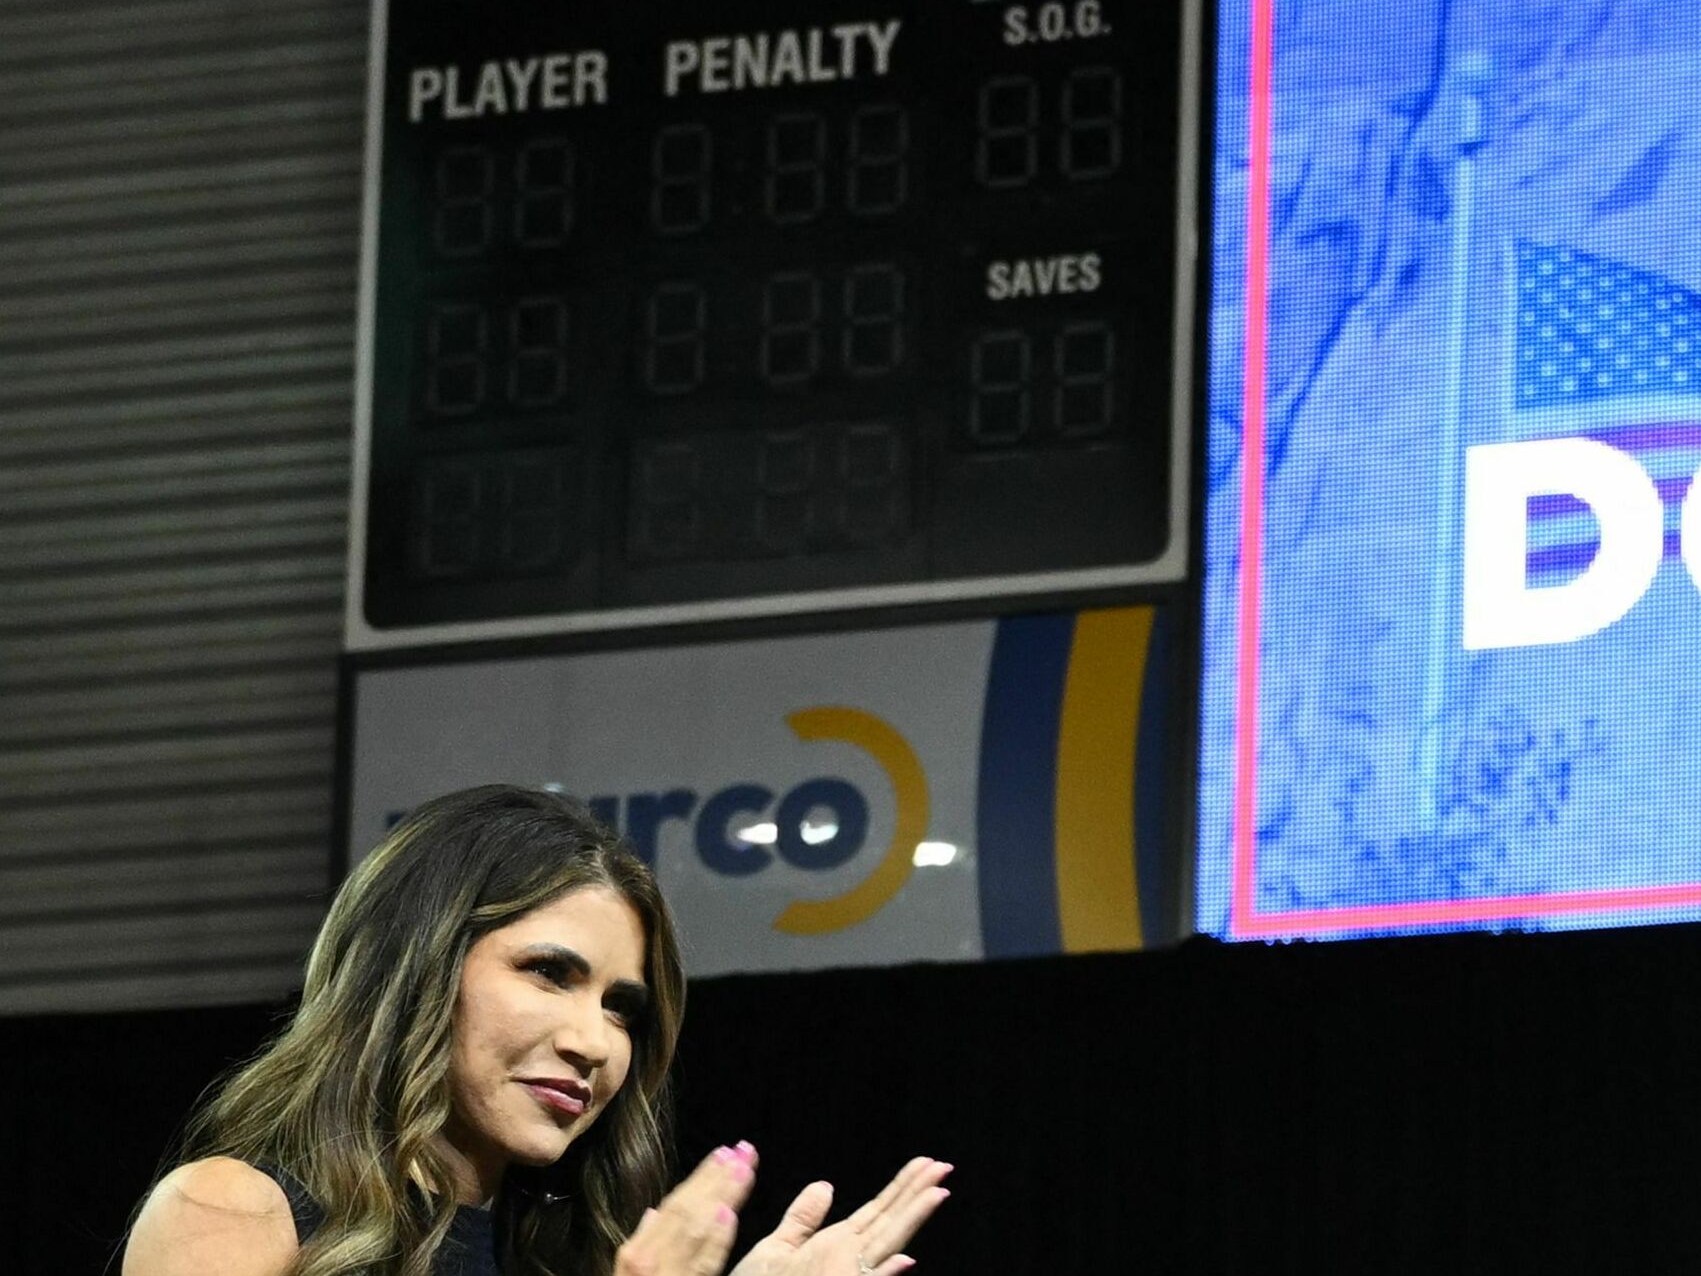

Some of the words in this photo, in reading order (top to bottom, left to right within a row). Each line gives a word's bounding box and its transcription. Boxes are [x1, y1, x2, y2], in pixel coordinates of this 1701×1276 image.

[408, 50, 609, 122] PLAYER
[665, 21, 901, 97] PENALTY
[986, 255, 1103, 301] SAVES
[588, 773, 870, 878] rco
